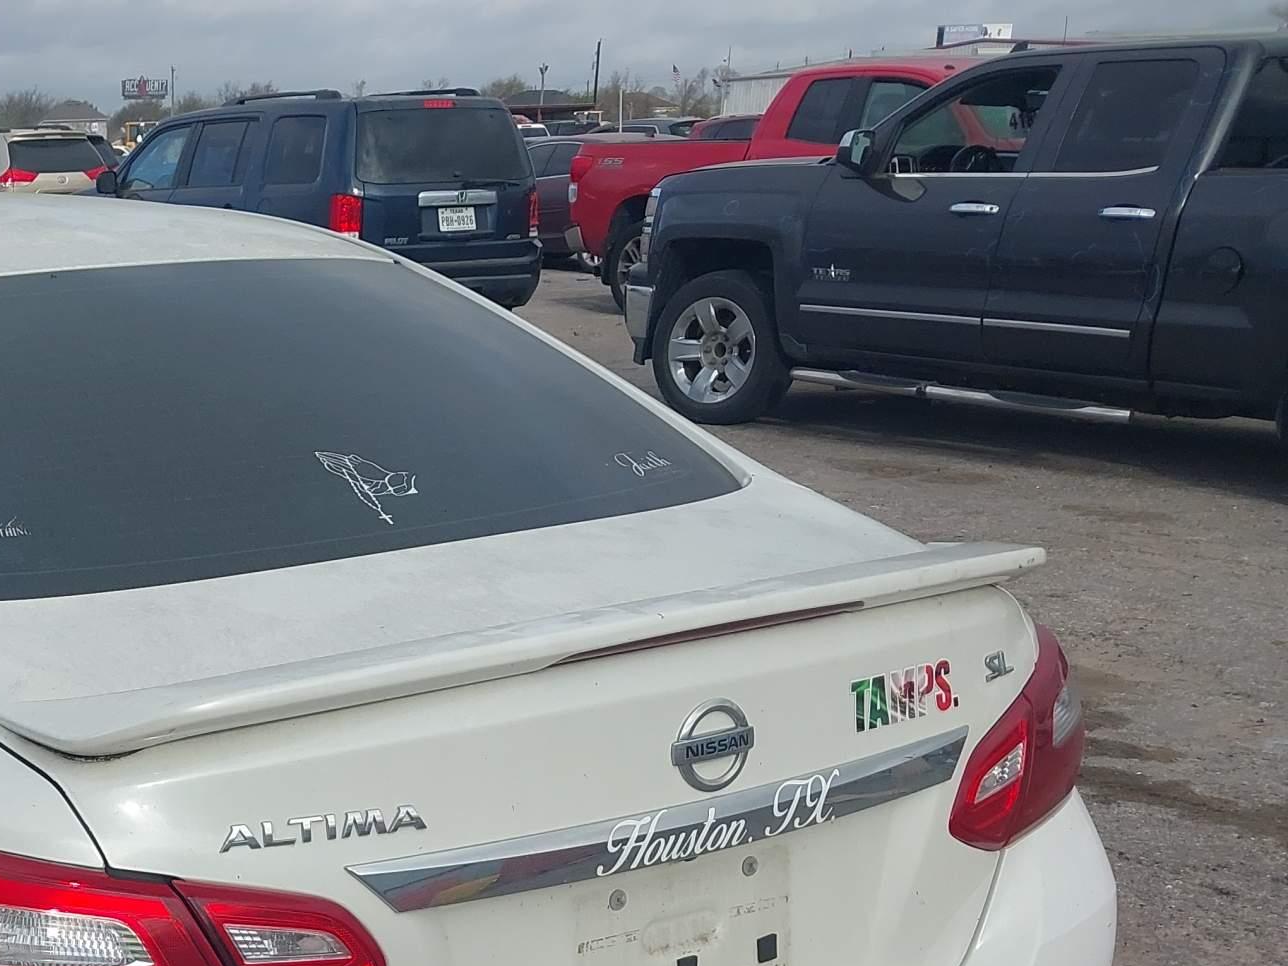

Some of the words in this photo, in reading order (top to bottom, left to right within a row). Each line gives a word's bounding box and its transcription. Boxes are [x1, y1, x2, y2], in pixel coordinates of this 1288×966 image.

[125, 80, 167, 92] ACCDENT?
[984, 650, 1014, 683] SL
[850, 658, 960, 734] TAMPS.
[685, 733, 749, 759] NISSAN
[218, 804, 428, 854] ALTIMA
